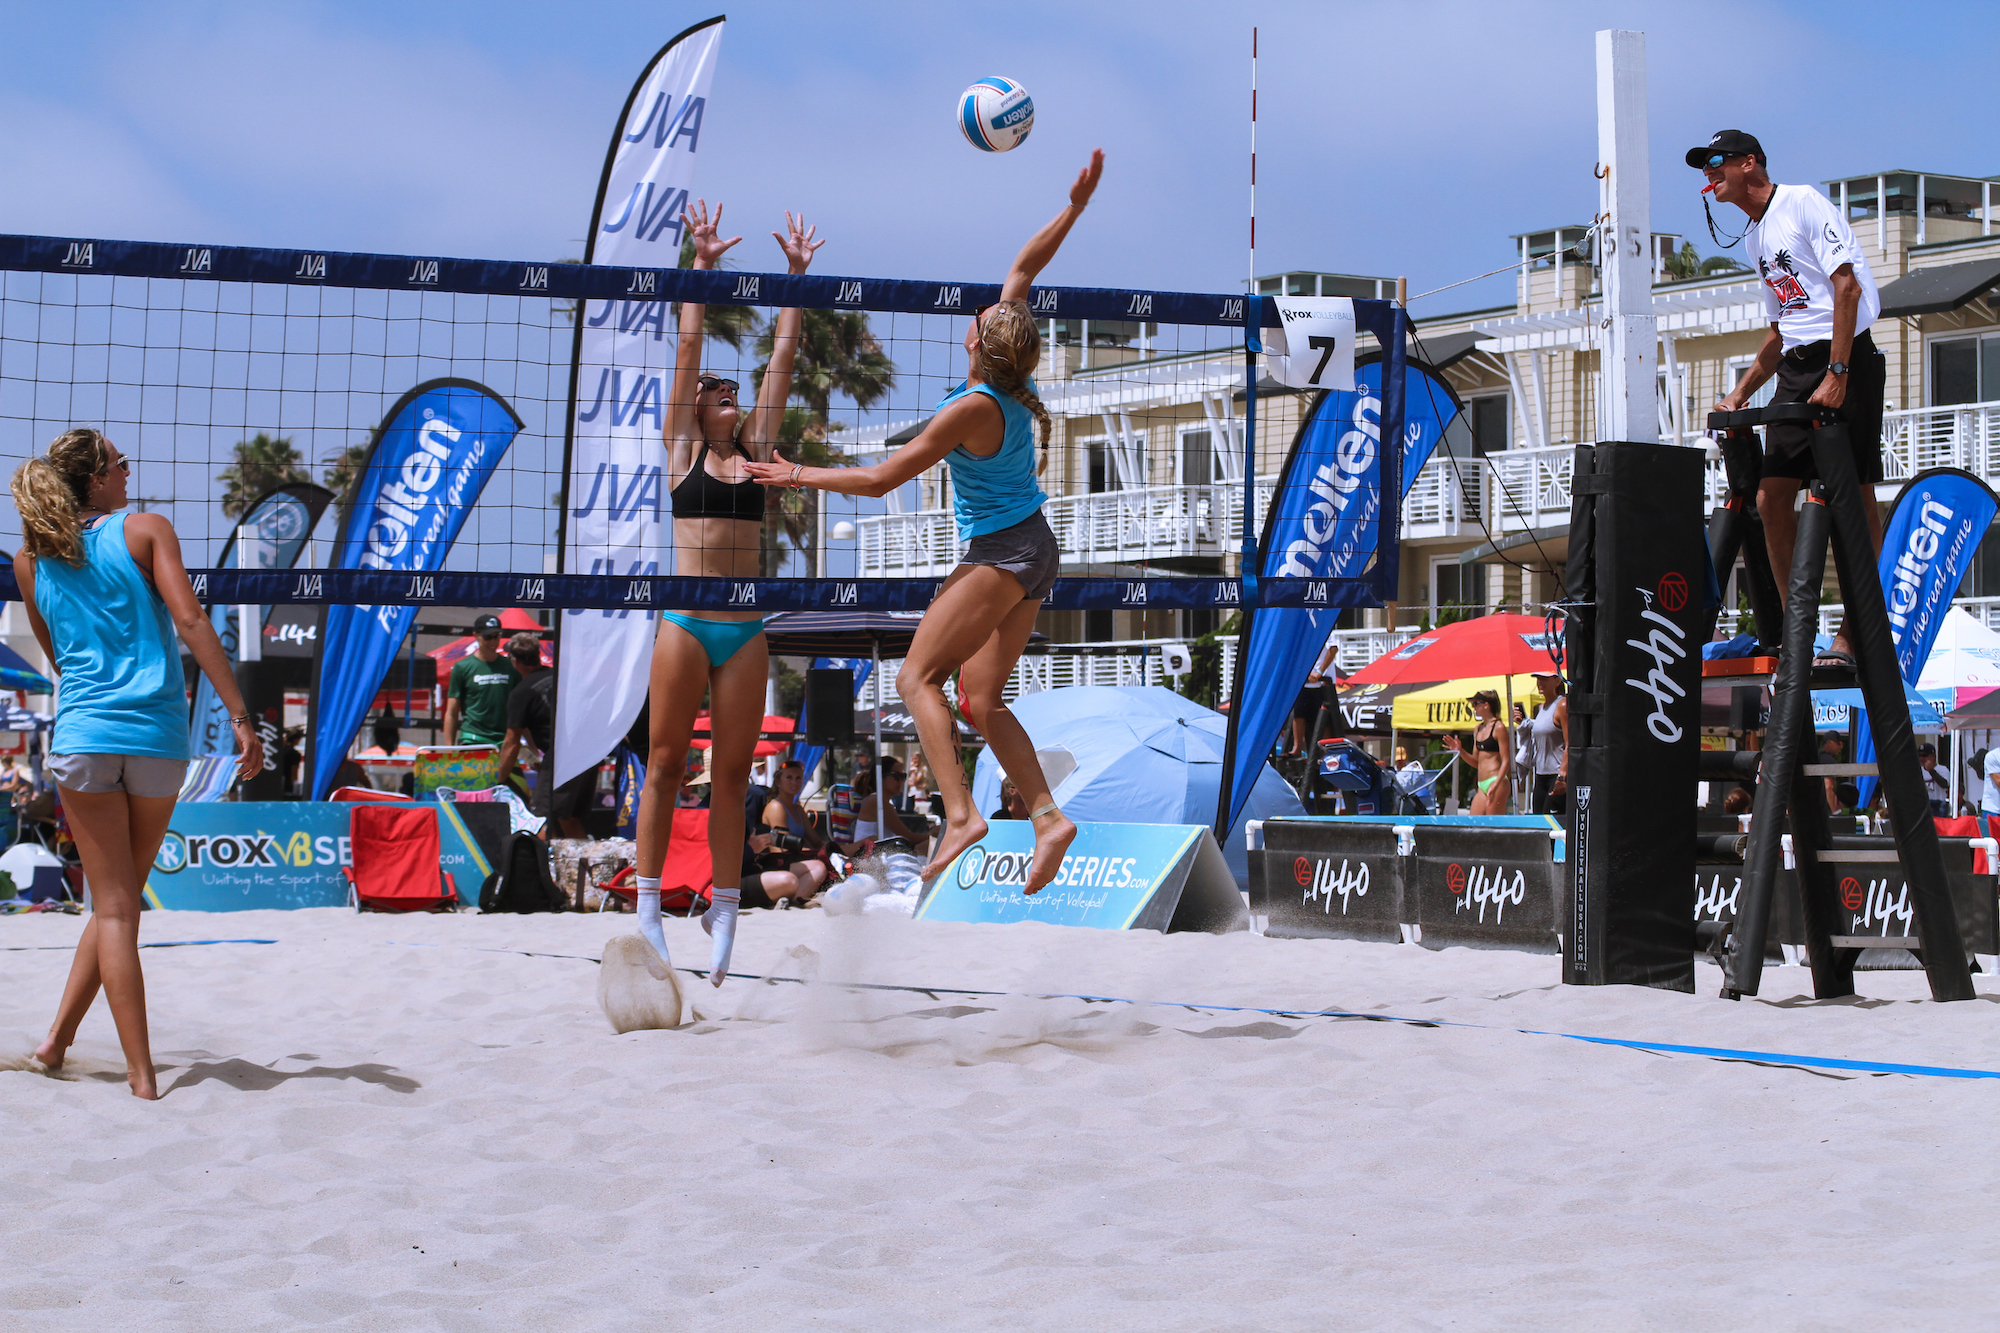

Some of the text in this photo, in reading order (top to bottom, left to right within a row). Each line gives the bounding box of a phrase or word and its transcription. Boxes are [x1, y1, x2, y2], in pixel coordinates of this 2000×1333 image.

[625, 91, 706, 153] JVA
[1003, 99, 1034, 124] molten
[603, 182, 689, 247] JVA
[61, 242, 94, 265] JVA
[180, 248, 212, 271] JVA
[296, 254, 326, 276] JVA
[409, 260, 439, 282] JVA
[520, 266, 548, 288] JVA
[627, 271, 655, 293] JVA
[732, 276, 760, 297] JVA
[835, 281, 863, 302] JVA
[934, 286, 961, 306] JVA
[1032, 290, 1058, 311] JVA
[1127, 294, 1152, 315] JVA
[1219, 299, 1243, 319] JVA
[1307, 335, 1335, 385] 7
[579, 367, 662, 431] JVA
[447, 440, 485, 510] game
[572, 462, 662, 524] JVA
[188, 574, 208, 597] VA
[292, 574, 323, 596] JVA
[406, 575, 435, 598] JVA
[516, 578, 545, 600] JVA
[624, 580, 652, 602] JVA
[728, 582, 756, 603] JVA
[830, 583, 858, 603] JVA
[1122, 582, 1148, 603] JVA
[1215, 582, 1239, 602] JVA
[1304, 581, 1328, 601] JVA
[1911, 611, 1929, 646] the
[1926, 564, 1947, 614] real
[1944, 518, 1972, 577] game
[1169, 655, 1183, 670] 9
[1626, 586, 1687, 743] p1440
[202, 871, 344, 895] Uniting the Sport of
[1302, 858, 1371, 915] p1440
[979, 889, 1109, 922] Uniting the Sport of Volleyball
[1455, 865, 1526, 925] p1440
[1851, 878, 1914, 937] p144
